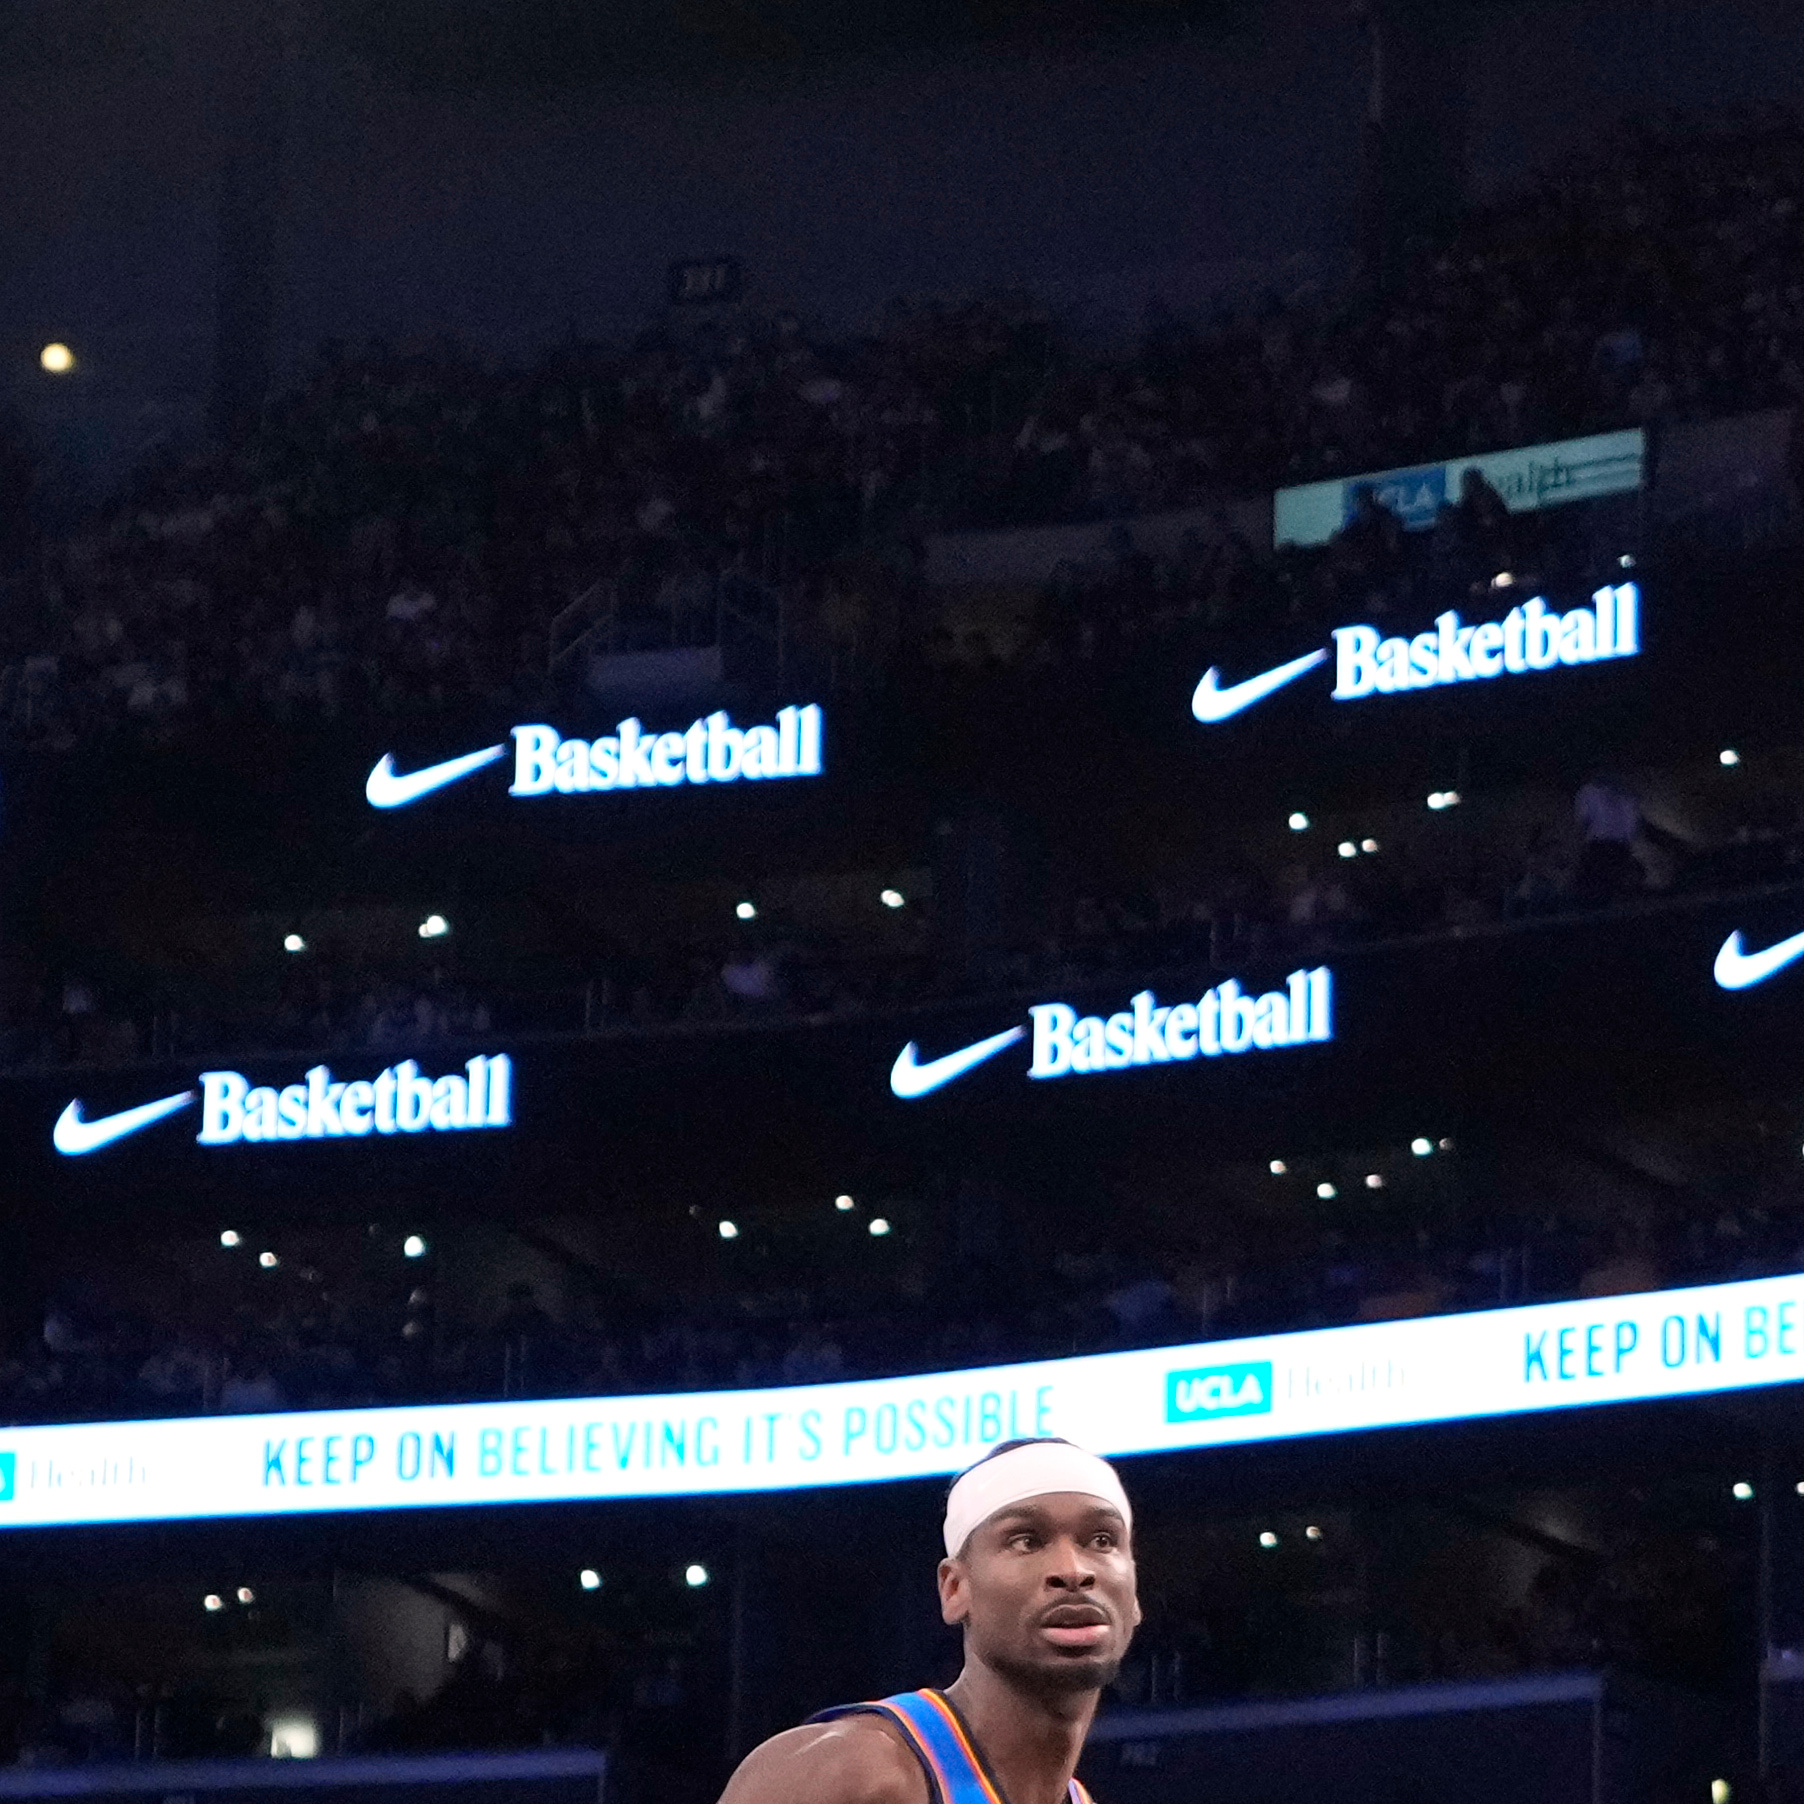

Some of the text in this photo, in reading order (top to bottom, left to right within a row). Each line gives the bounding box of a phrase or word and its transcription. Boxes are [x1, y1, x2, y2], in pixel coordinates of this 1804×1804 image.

[1331, 580, 1640, 701] Basketball
[508, 703, 823, 797] Basketball
[1026, 966, 1332, 1080] Basketball
[196, 1053, 512, 1145] Basketball
[1175, 1373, 1264, 1413] UCLA
[1523, 1319, 1640, 1384] KEEP
[1660, 1311, 1721, 1370] ON
[262, 1386, 1055, 1487] KEEP ON BELIEVING IT'S POSSIBLE
